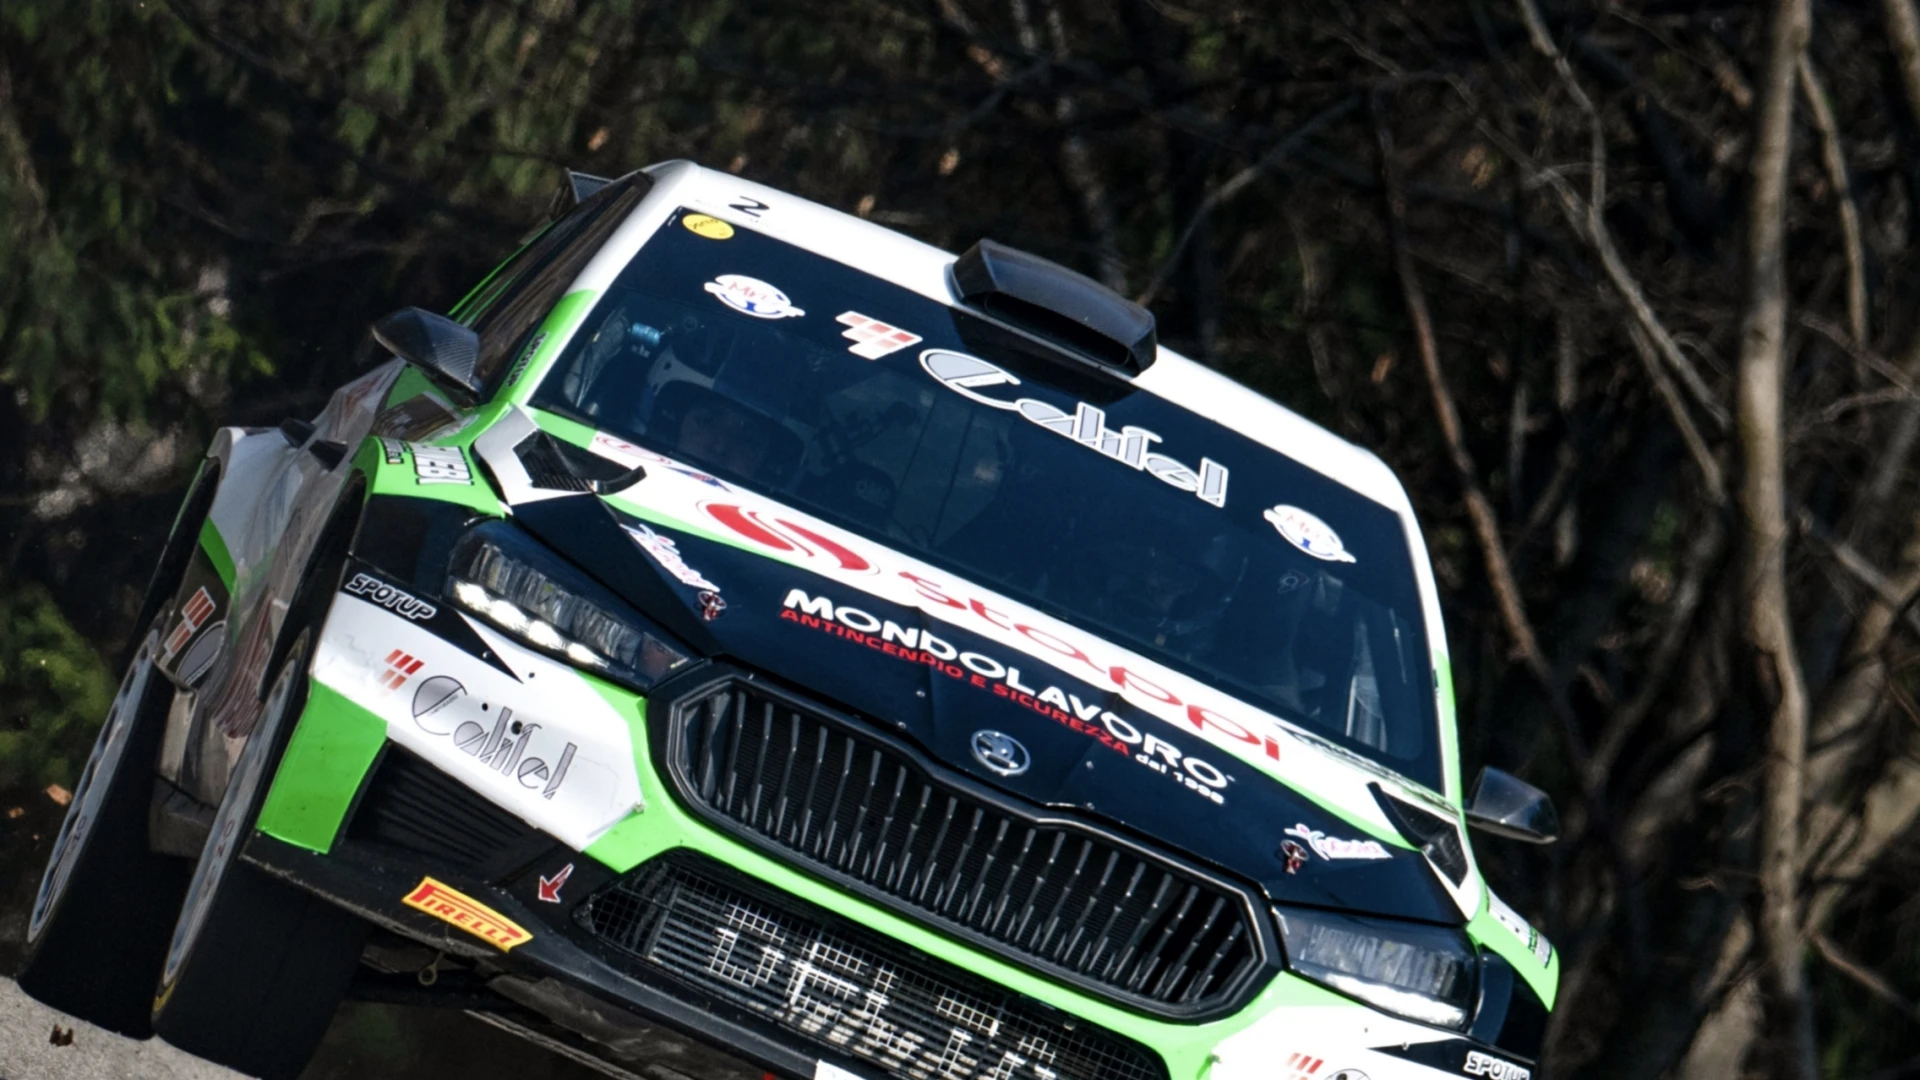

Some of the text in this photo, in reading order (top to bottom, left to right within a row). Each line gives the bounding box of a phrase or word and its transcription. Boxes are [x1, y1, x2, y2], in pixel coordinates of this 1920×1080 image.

[728, 195, 770, 218] 2
[919, 348, 1230, 508] Califel
[345, 573, 437, 620] SPOTUP
[780, 609, 1131, 757] ANTINCENDIO E SICUREZZA
[783, 588, 1228, 788] MONDOLAVORO
[412, 675, 578, 801] Califel
[1135, 753, 1168, 774] dal
[409, 883, 523, 944] PIRELLI
